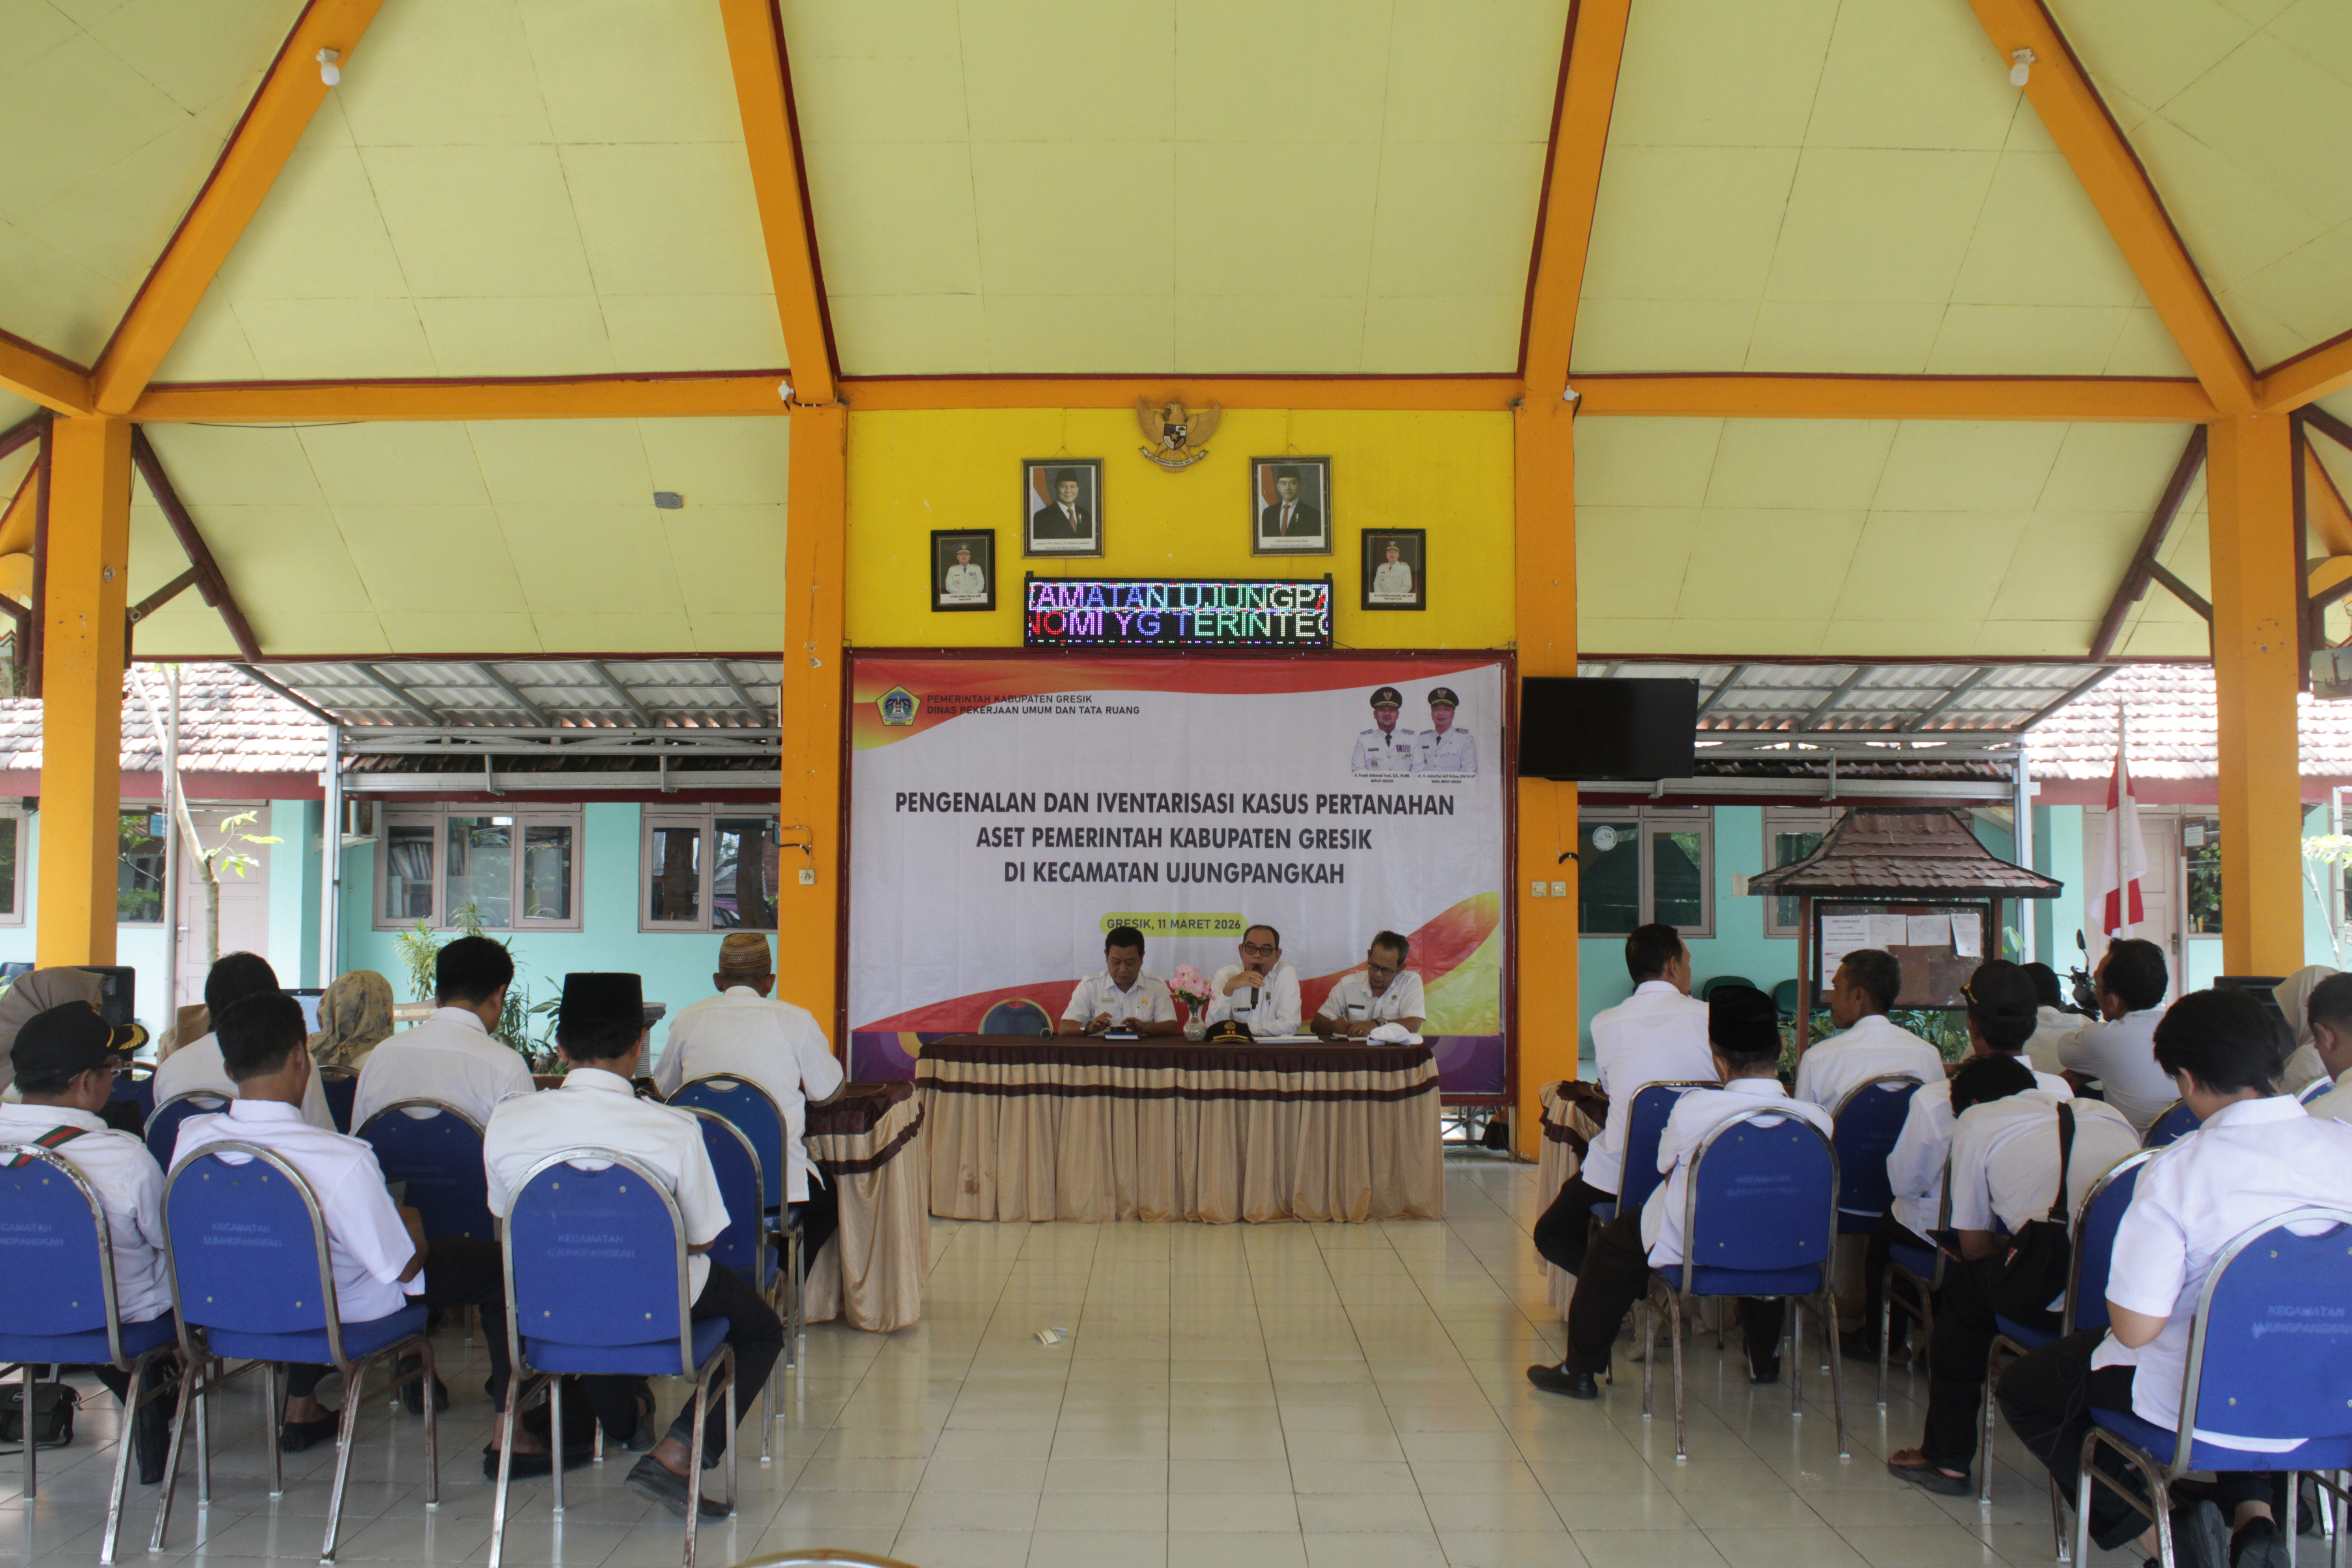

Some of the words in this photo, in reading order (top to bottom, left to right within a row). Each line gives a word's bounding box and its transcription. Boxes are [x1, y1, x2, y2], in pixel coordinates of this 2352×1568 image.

[1114, 611, 1160, 635] YG
[896, 792, 1036, 813] PENGENALAN
[1044, 792, 1089, 813] DAN
[1097, 793, 1234, 814] IVENTARISASI
[1243, 793, 1308, 814] KASUS
[1316, 794, 1454, 815] PERTANAHAN
[976, 827, 1025, 848] ASET
[1032, 827, 1162, 848] PEMERINTAH
[1171, 828, 1290, 849] KABUPATEN
[1299, 828, 1372, 849] GRESIK
[1005, 862, 1025, 882] DI
[1033, 862, 1158, 882] KECAMATAN
[1167, 862, 1344, 884] UJUNGPANGKAH
[1107, 919, 1154, 930] GRESIK,
[1158, 919, 1166, 929] 11
[1171, 919, 1211, 929] MARET
[1214, 919, 1241, 929] 2026
[212, 1222, 270, 1233] KECAMATAN
[557, 1234, 623, 1243] KECAMATAN
[2268, 1306, 2345, 1317] KECAMATAN
